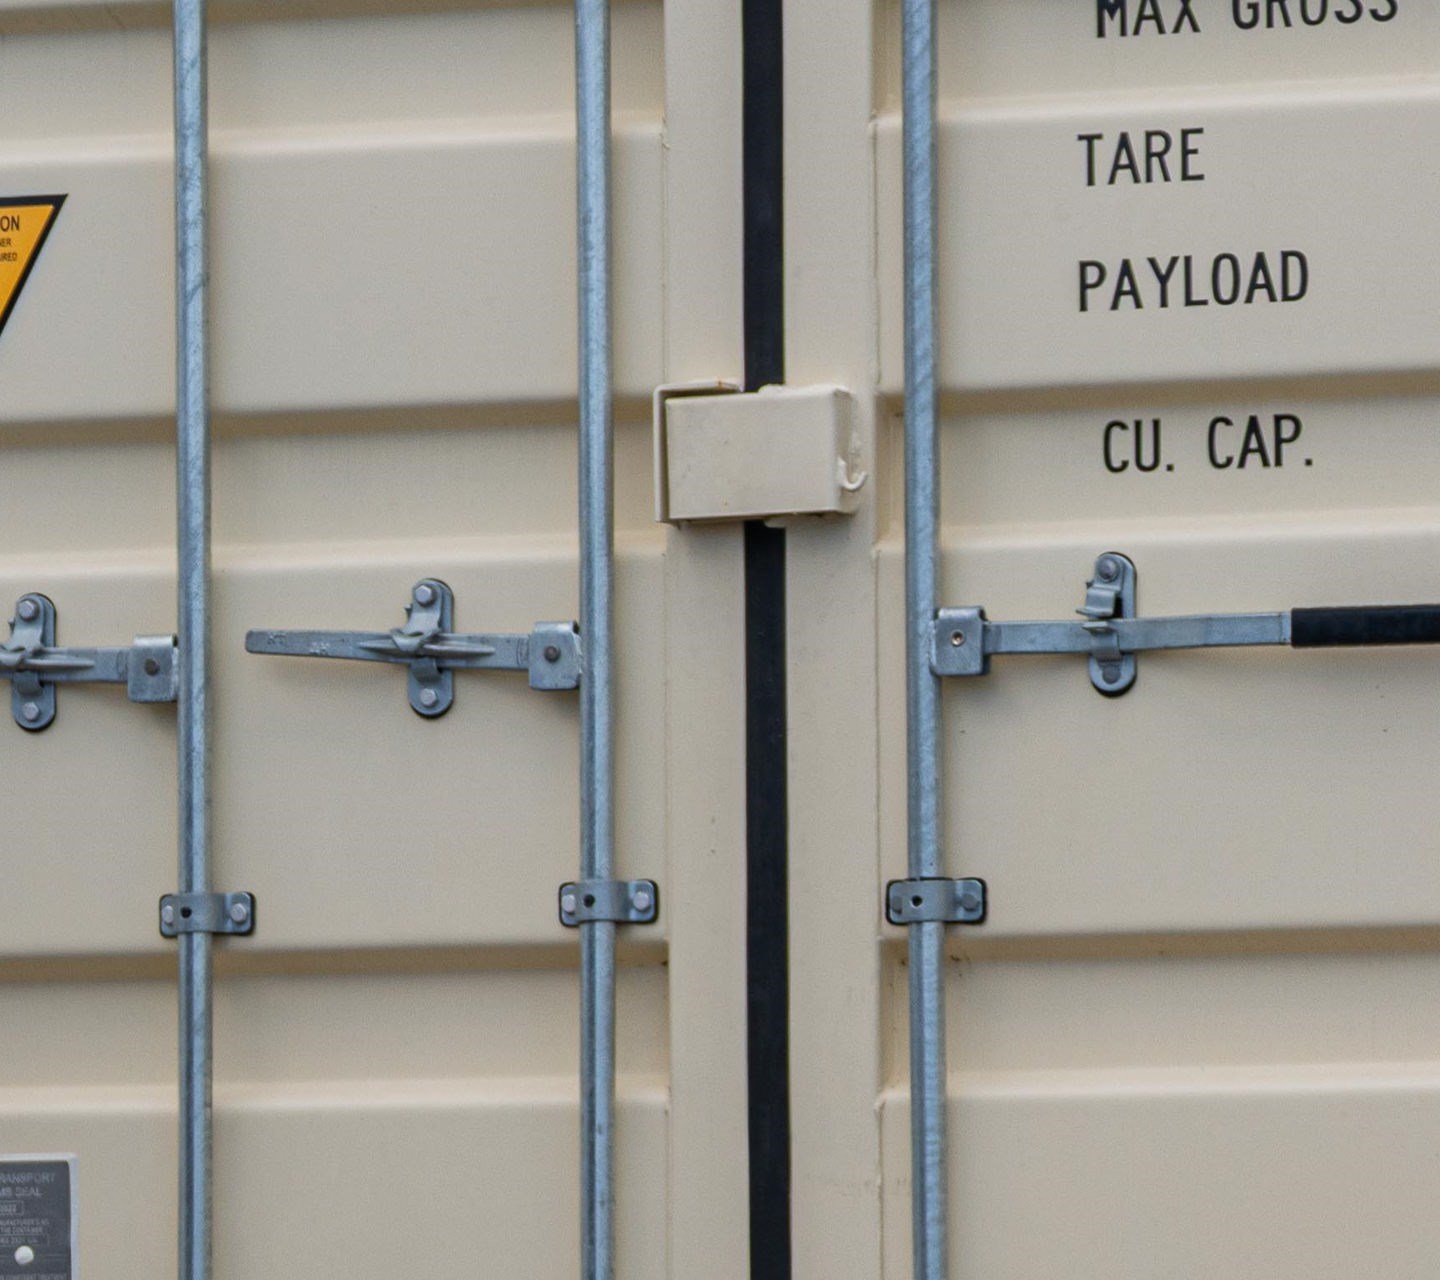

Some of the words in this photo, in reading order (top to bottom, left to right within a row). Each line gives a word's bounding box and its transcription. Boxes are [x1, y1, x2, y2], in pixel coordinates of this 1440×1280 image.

[1077, 127, 1205, 187] TARE
[1078, 250, 1309, 312] PAYLOAD
[1102, 419, 1175, 473] CU.
[1207, 414, 1313, 469] CAP.
